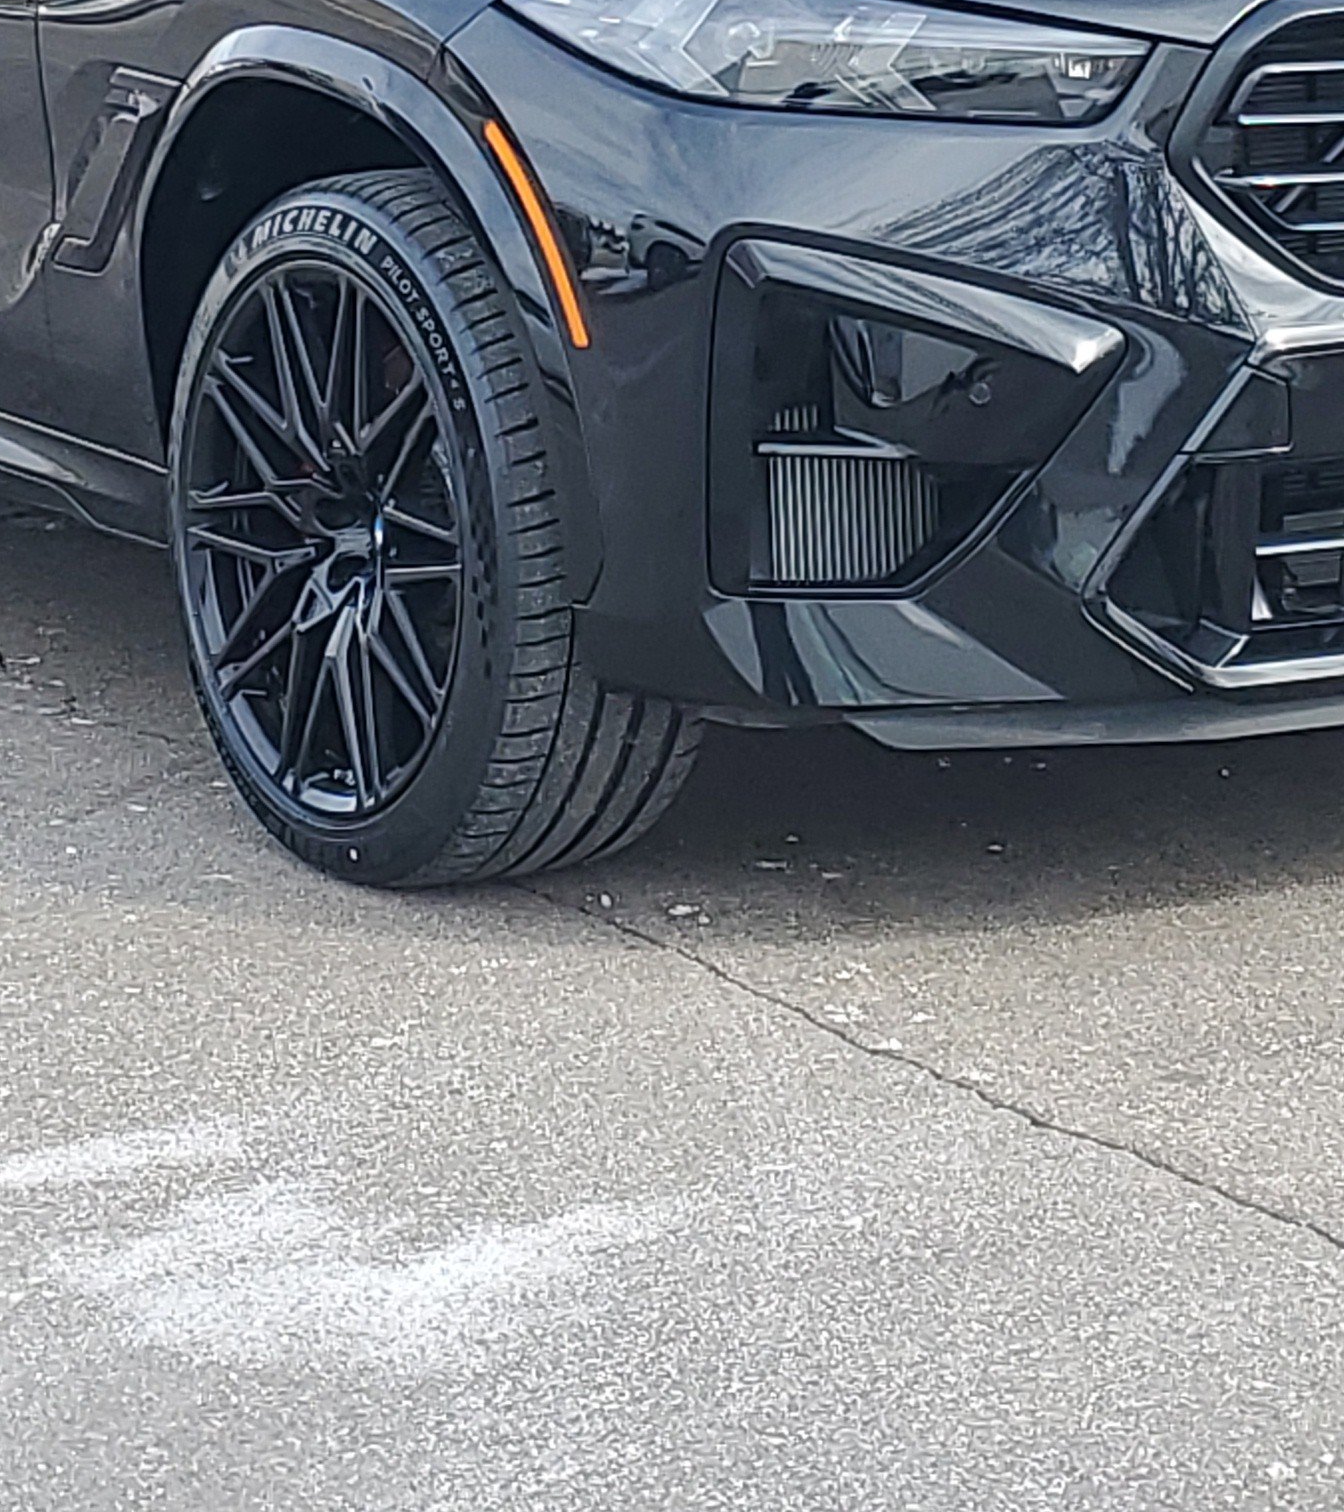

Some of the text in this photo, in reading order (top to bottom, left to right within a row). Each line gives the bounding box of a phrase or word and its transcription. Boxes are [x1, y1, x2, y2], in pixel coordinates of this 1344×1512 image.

[251, 207, 377, 255] MICHELIN
[380, 255, 420, 303] PILOT
[416, 306, 456, 375] SPORT
